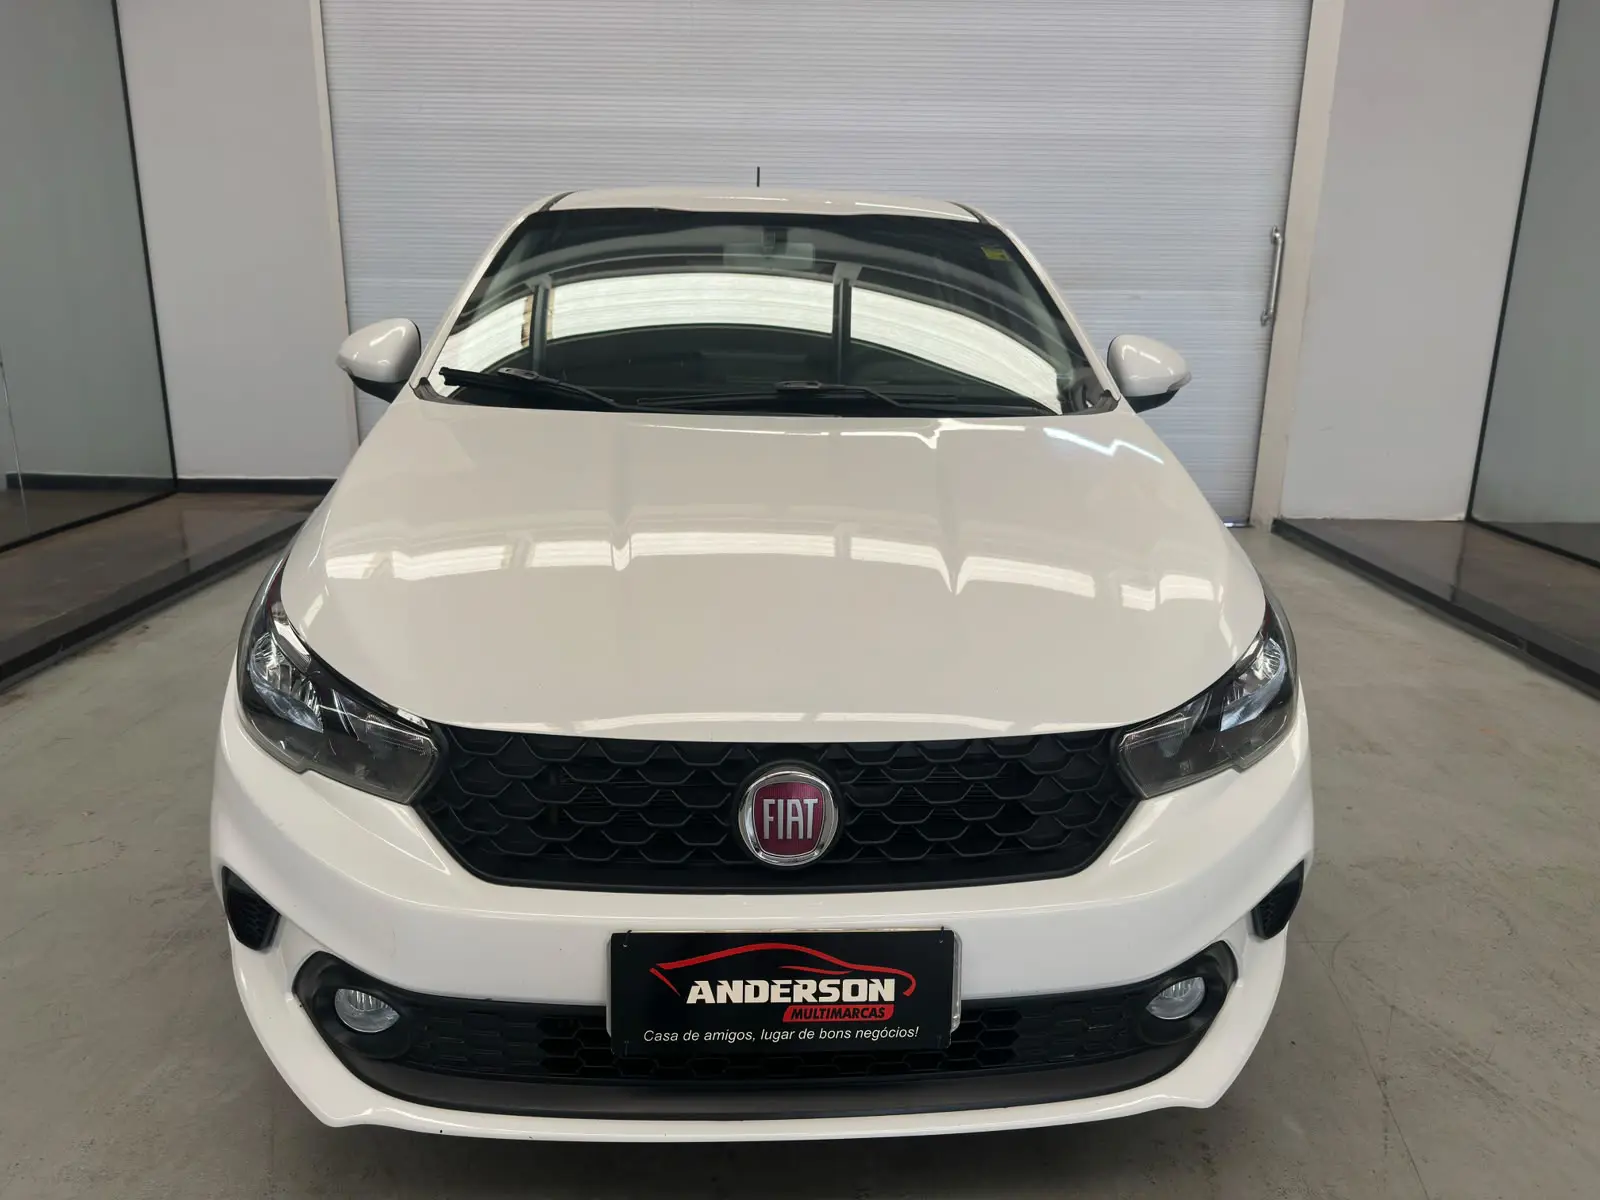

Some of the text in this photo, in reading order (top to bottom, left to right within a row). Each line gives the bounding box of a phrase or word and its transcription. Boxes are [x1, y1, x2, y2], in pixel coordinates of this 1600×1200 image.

[763, 798, 818, 840] FIAT
[686, 978, 896, 1004] ANDERSON
[790, 1006, 886, 1020] MULTIMARCAS
[643, 1026, 920, 1044] Casa de amigos, lugar de bons negócios!
